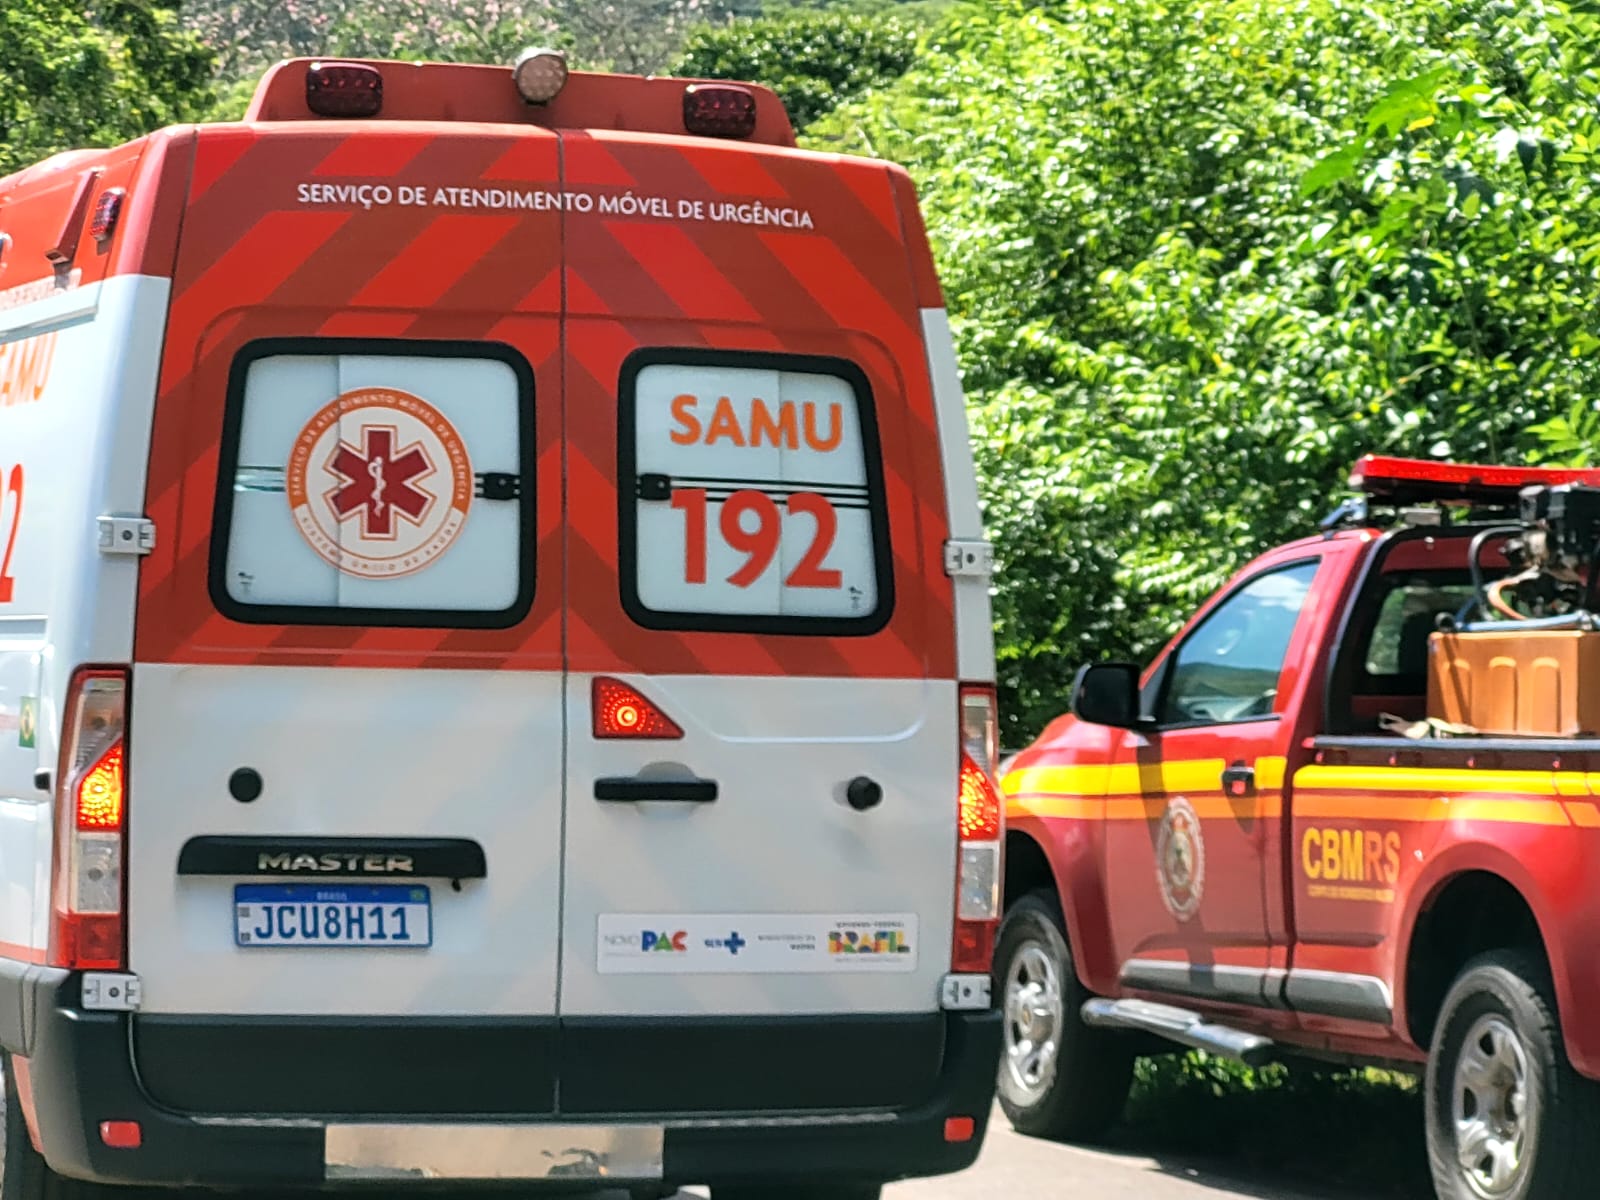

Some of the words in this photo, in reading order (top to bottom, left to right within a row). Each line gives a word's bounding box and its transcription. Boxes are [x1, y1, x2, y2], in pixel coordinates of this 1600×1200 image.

[297, 183, 393, 210] SERVIÇO
[398, 186, 427, 206] DE
[432, 187, 594, 212] ATENDIMENTO
[598, 191, 673, 218] MÓVEL
[678, 200, 705, 220] DE
[709, 201, 814, 229] URGÊNCIA
[0, 331, 59, 406] AMU
[669, 394, 843, 452] SAMU
[671, 488, 842, 589] 192
[257, 852, 414, 872] MASTER
[1302, 827, 1400, 883] CBMRS
[254, 905, 411, 940] JCU8H11
[641, 931, 688, 952] PAC
[828, 930, 911, 954] BRASIL
